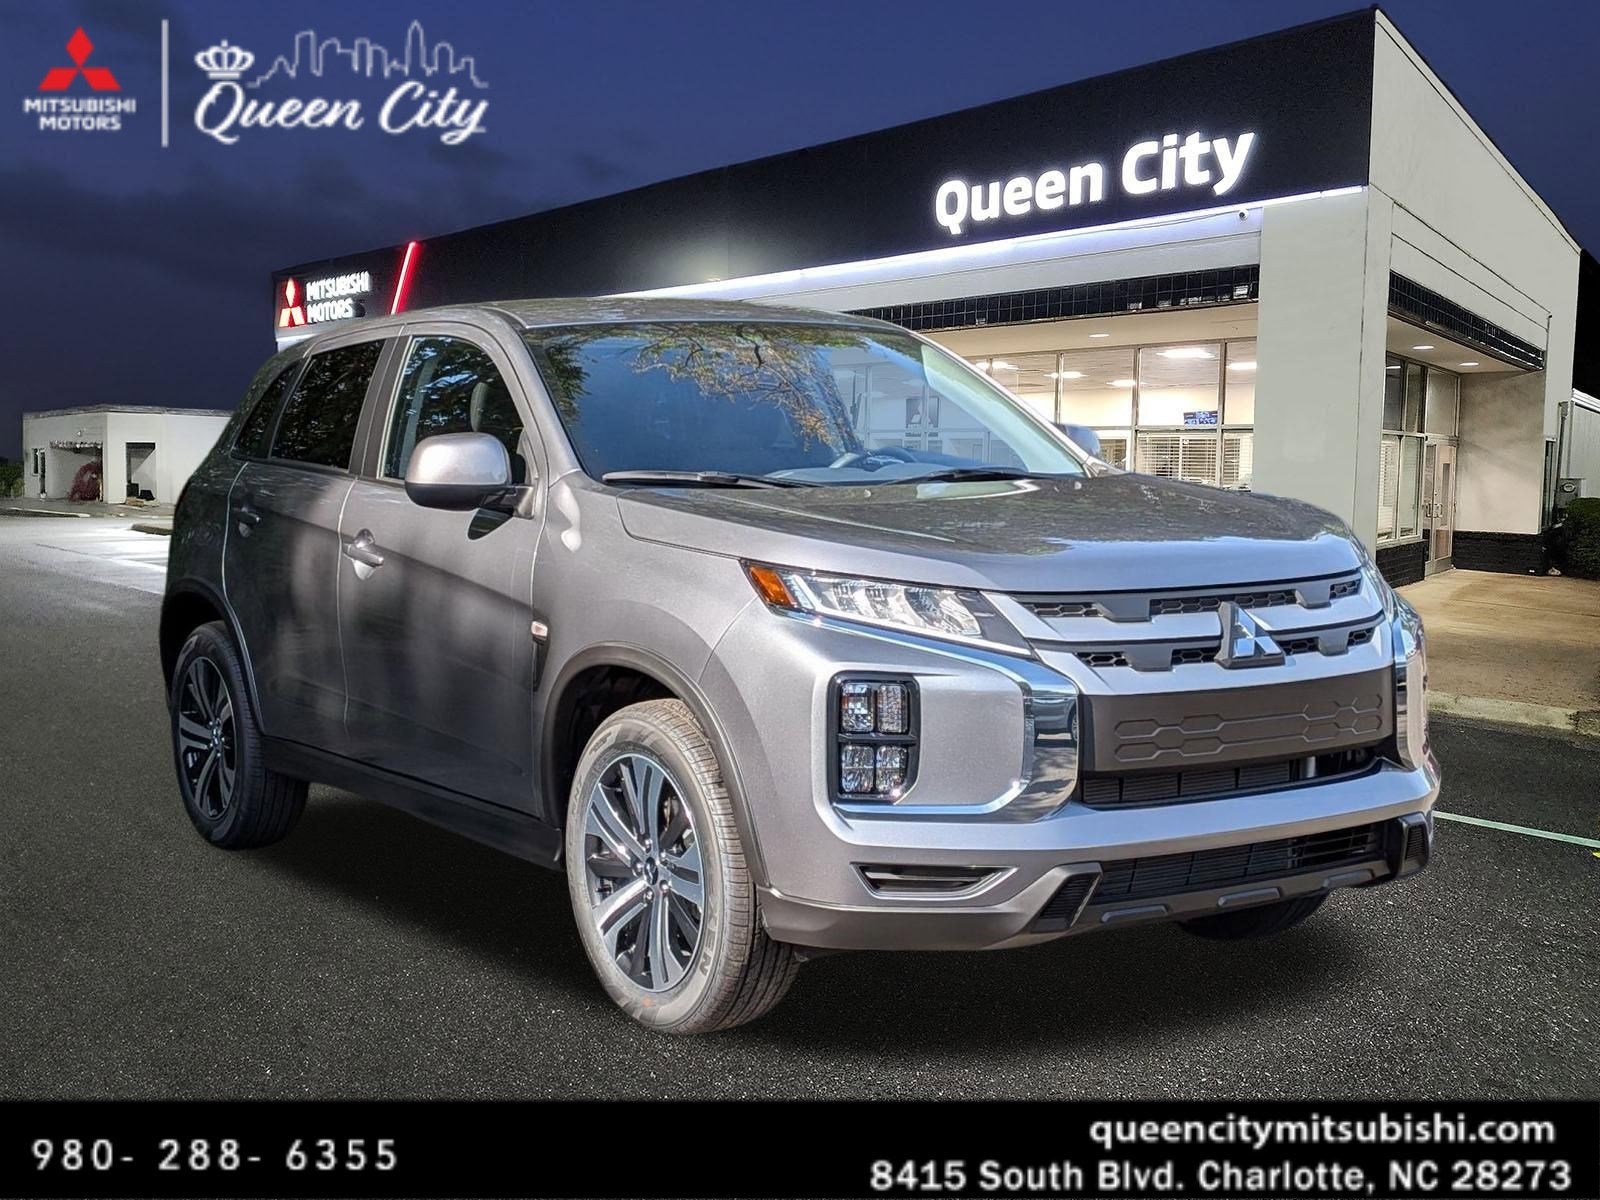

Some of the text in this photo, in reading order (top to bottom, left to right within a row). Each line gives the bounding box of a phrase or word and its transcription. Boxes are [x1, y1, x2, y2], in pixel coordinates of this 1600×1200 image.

[935, 131, 1256, 235] Queen City
[305, 270, 370, 301] MITSUBISHI
[306, 298, 355, 324] MOTORS
